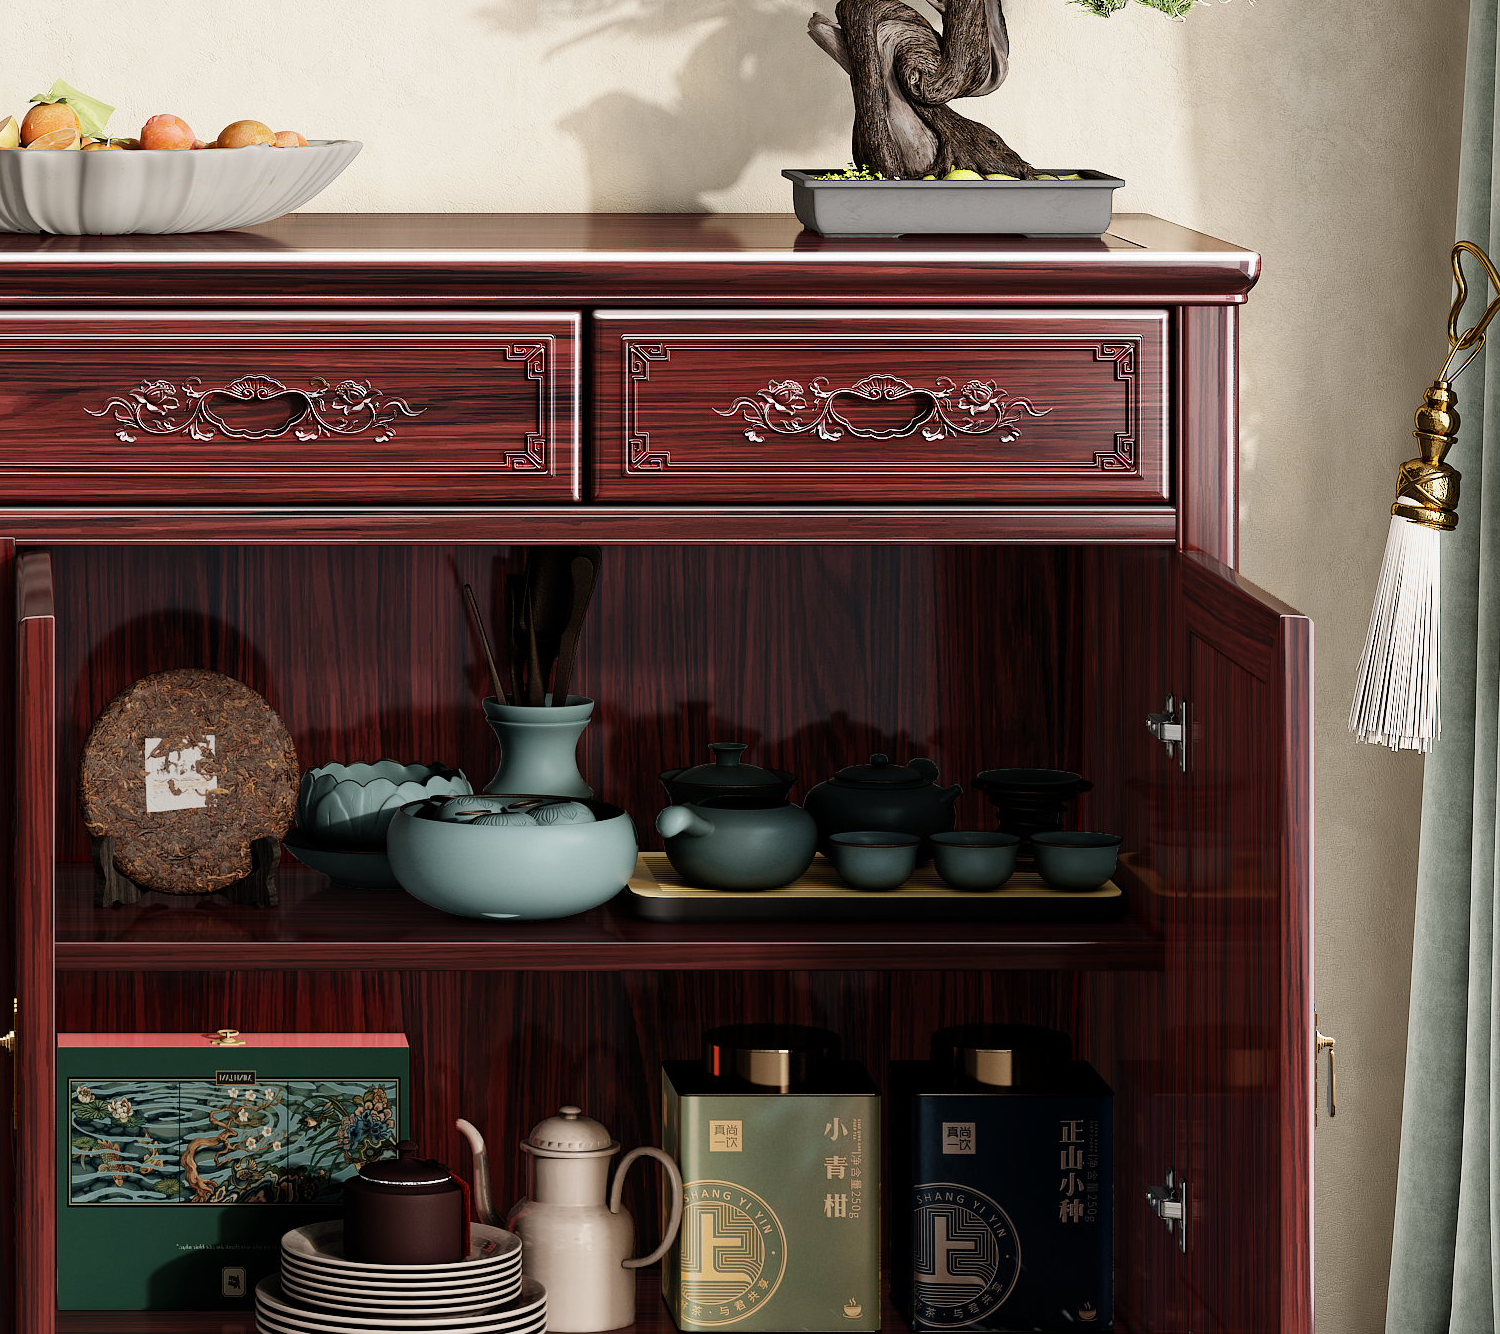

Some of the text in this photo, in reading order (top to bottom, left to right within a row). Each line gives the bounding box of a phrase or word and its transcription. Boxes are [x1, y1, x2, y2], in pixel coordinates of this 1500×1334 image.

[823, 1117, 849, 1218] 小青柑
[1058, 1119, 1085, 1223] 正山小种
[683, 1189, 773, 1234] SHANG YI YIN
[916, 1192, 1008, 1238] SHANG YI YIN
